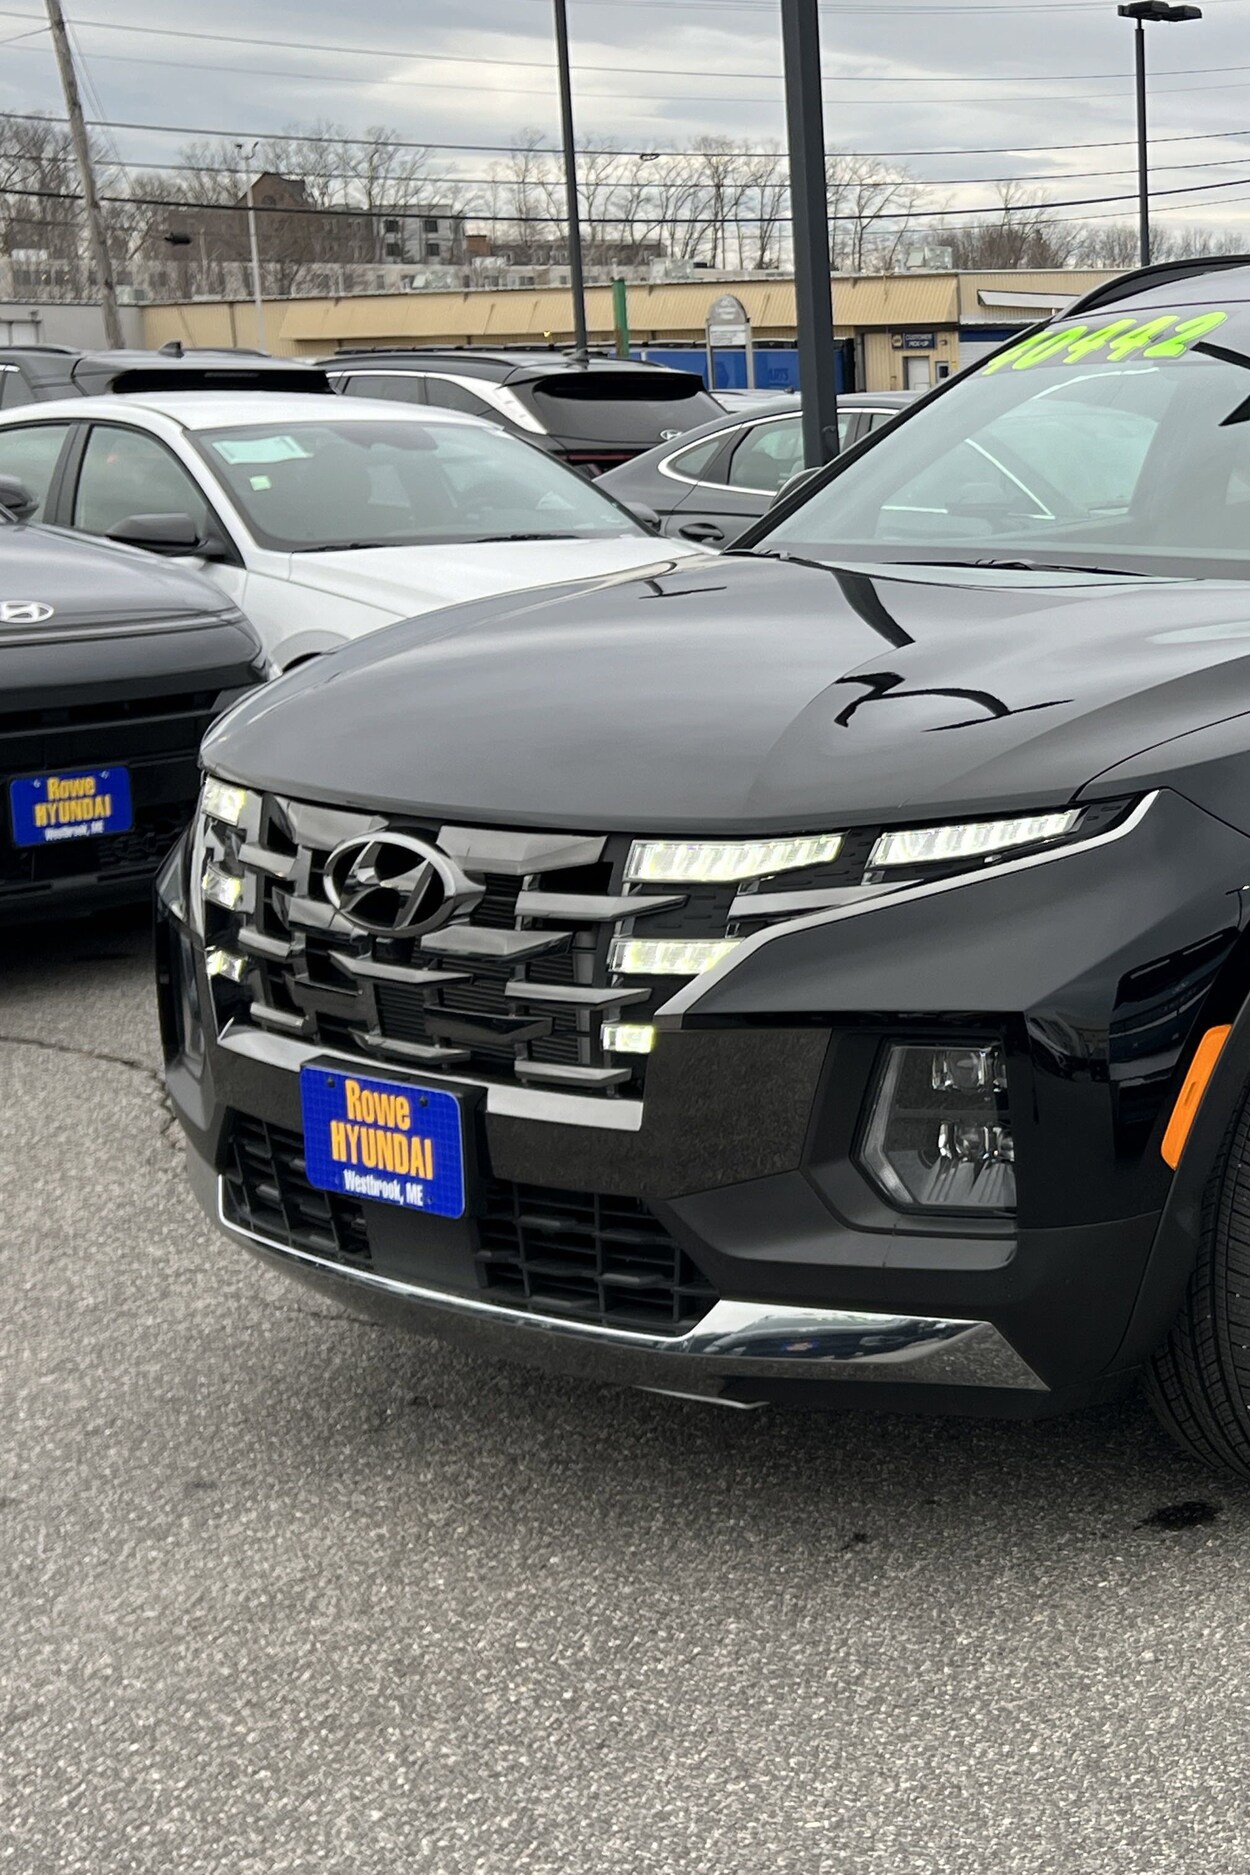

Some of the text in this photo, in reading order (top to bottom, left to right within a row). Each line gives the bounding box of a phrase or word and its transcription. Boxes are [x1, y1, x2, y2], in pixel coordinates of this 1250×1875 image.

[981, 311, 1228, 376] 40442
[35, 794, 112, 828] HYUNDAI
[47, 776, 96, 801] Rowe
[344, 1078, 411, 1131] Rowe
[330, 1119, 434, 1181] HYUNDAI
[343, 1168, 424, 1207] Westbrook, ME
